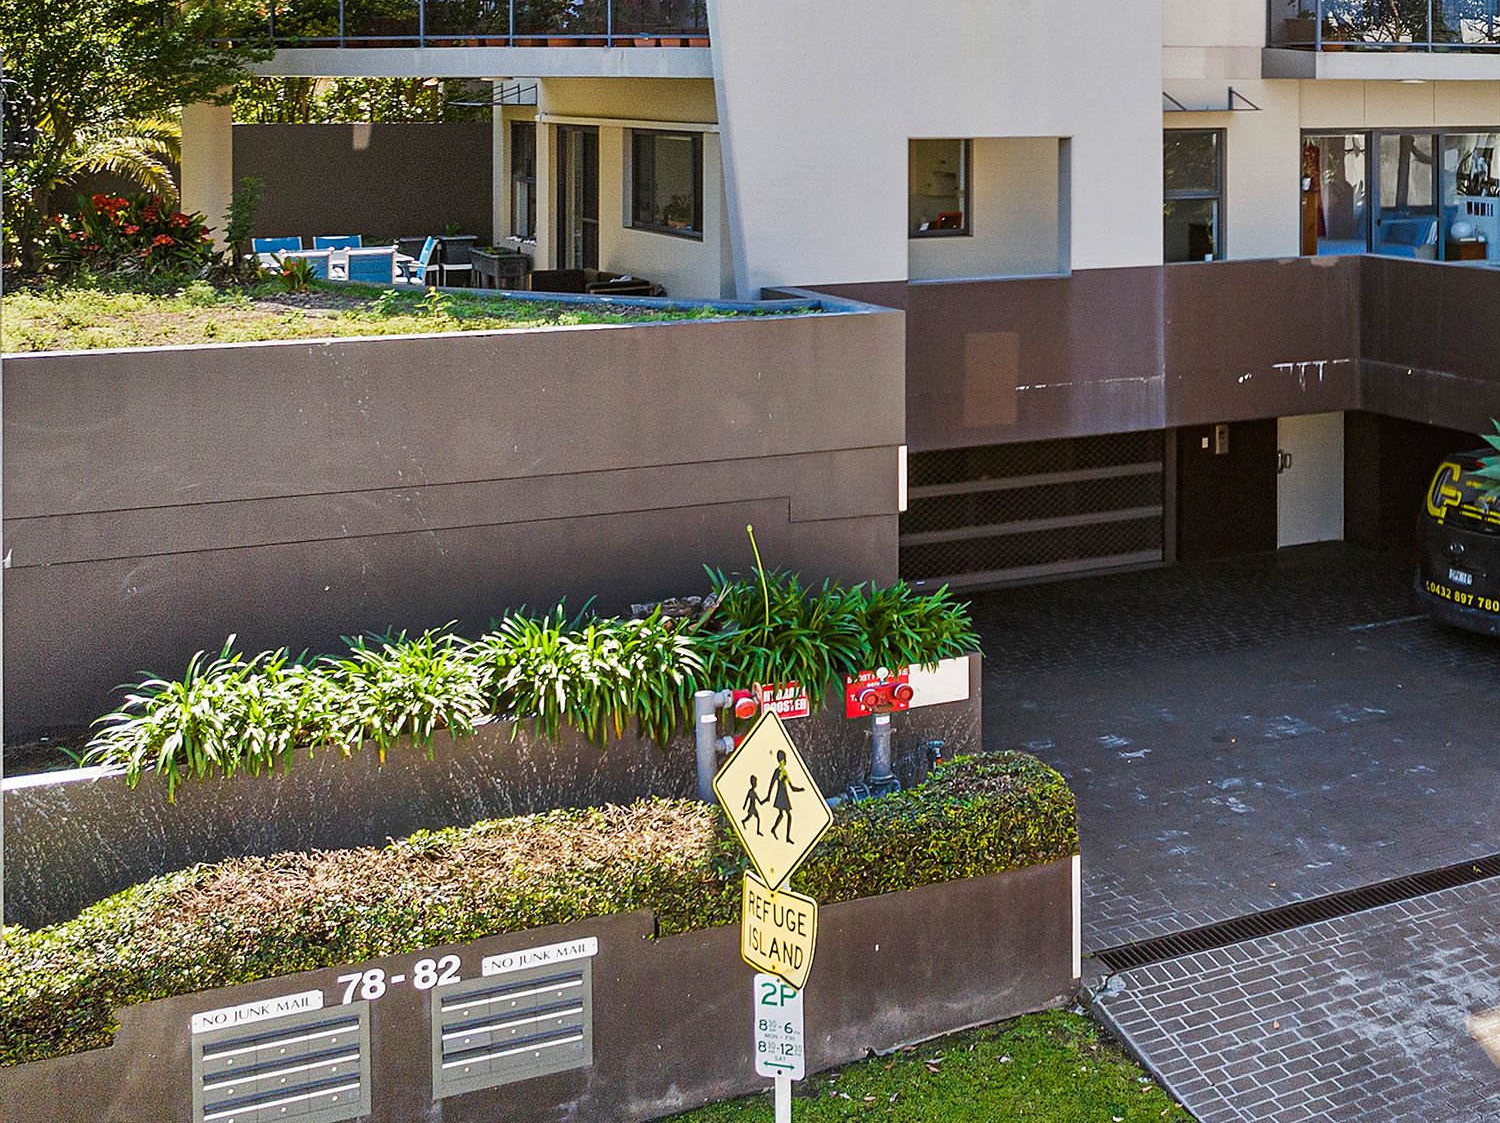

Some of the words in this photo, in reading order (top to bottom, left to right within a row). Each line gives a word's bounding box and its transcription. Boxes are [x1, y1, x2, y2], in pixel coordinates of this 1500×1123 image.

[1430, 581, 1451, 599] 0432
[1454, 590, 1474, 605] 897
[1478, 597, 1500, 612] 780
[749, 890, 806, 937] REFUGE
[492, 957, 513, 970] NO
[519, 950, 551, 966] JUNK
[556, 943, 589, 958] MAIL
[749, 924, 803, 969] ISLAND
[761, 982, 797, 1006] 2P
[202, 1013, 227, 1027] NO
[234, 1005, 270, 1022] JUNK
[276, 997, 311, 1012] MAIL
